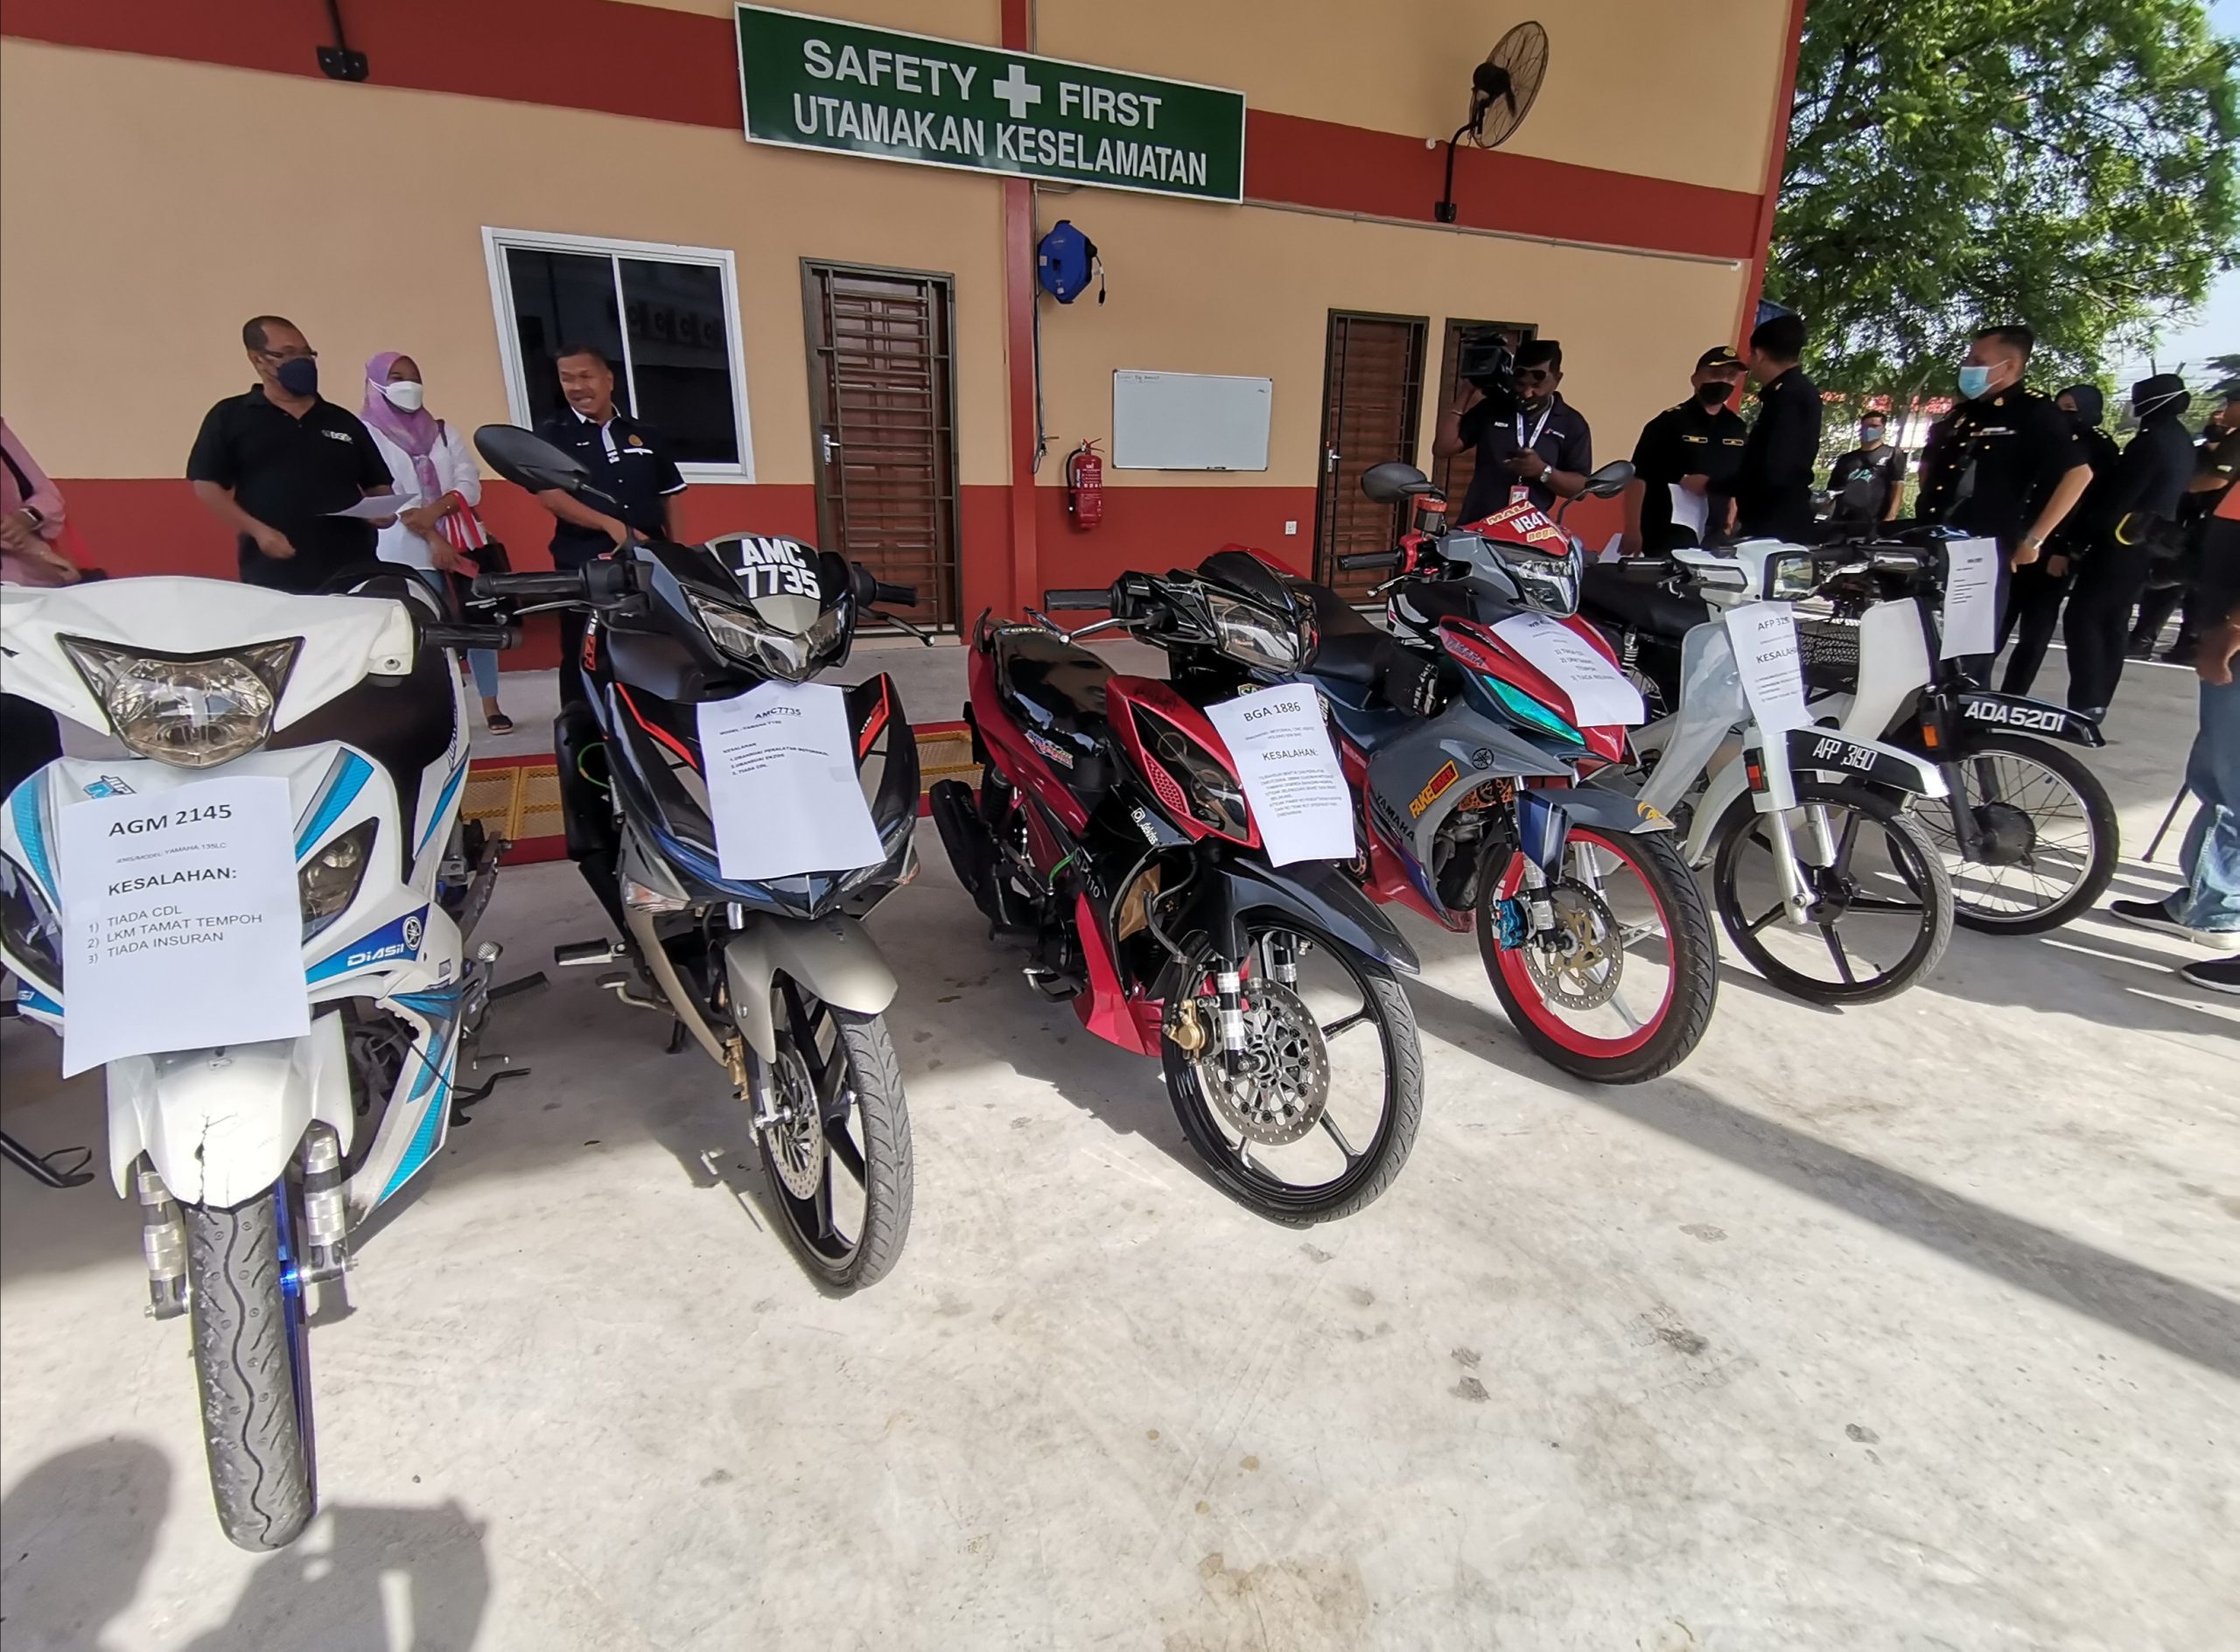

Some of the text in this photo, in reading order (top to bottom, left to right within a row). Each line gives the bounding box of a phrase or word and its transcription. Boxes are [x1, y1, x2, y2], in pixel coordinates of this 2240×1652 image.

[802, 38, 1162, 130] SAFETY FIRST
[793, 93, 1208, 186] UTAMAKAN KESELAMATAN
[741, 537, 807, 568] AMC
[734, 564, 821, 598] 7735
[1757, 619, 1774, 631] AFP
[754, 706, 802, 719] AMC7735
[1243, 702, 1301, 722] BGA 1886
[1262, 748, 1319, 760] KESALAHAN:
[1812, 738, 1843, 760] AFP
[1376, 790, 1415, 842] YAMAHA
[1409, 786, 1436, 820] FAKE
[108, 804, 232, 837] AGM 2145
[164, 844, 200, 855] YAMAHA
[108, 867, 237, 896] KESALAHAN:
[88, 905, 183, 934] 1) TIADA CDL
[88, 914, 263, 949] 2) LKM TAMAT TEMPOH
[88, 932, 224, 965] 3) TIADA INSURAN
